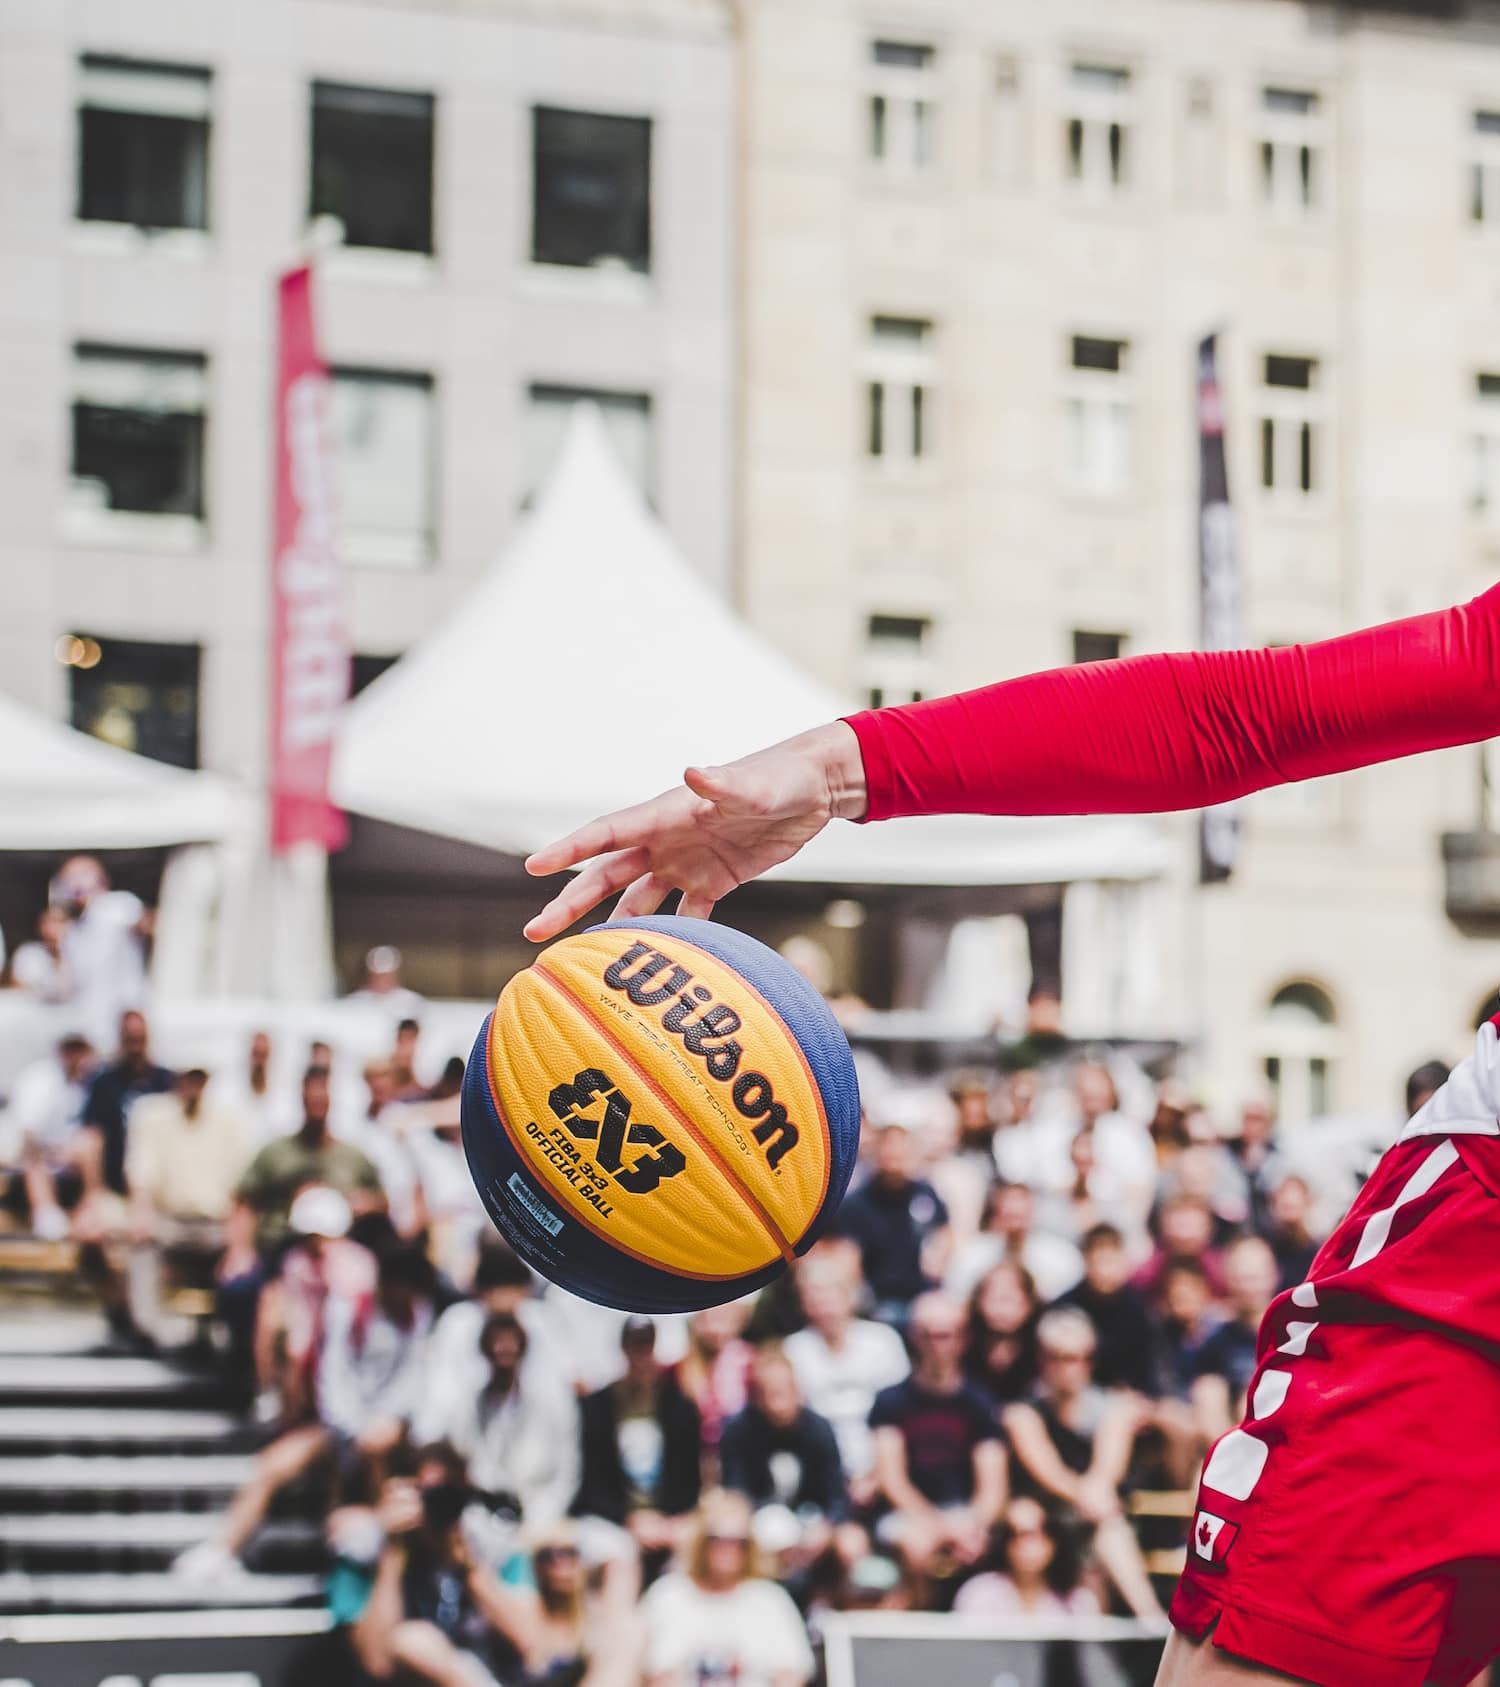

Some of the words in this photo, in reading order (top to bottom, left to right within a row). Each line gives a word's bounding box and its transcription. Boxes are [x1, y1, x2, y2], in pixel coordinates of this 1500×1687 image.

[599, 993, 633, 1021] WAVE
[637, 1020, 668, 1051] TRIPLE
[669, 1048, 703, 1087] THREAT
[702, 1086, 752, 1157] TECHNOLOGY
[603, 939, 799, 1172] Wilson
[525, 1121, 582, 1187] OFFICIAL
[578, 1184, 614, 1220] BALL
[549, 1127, 582, 1164] FIBA
